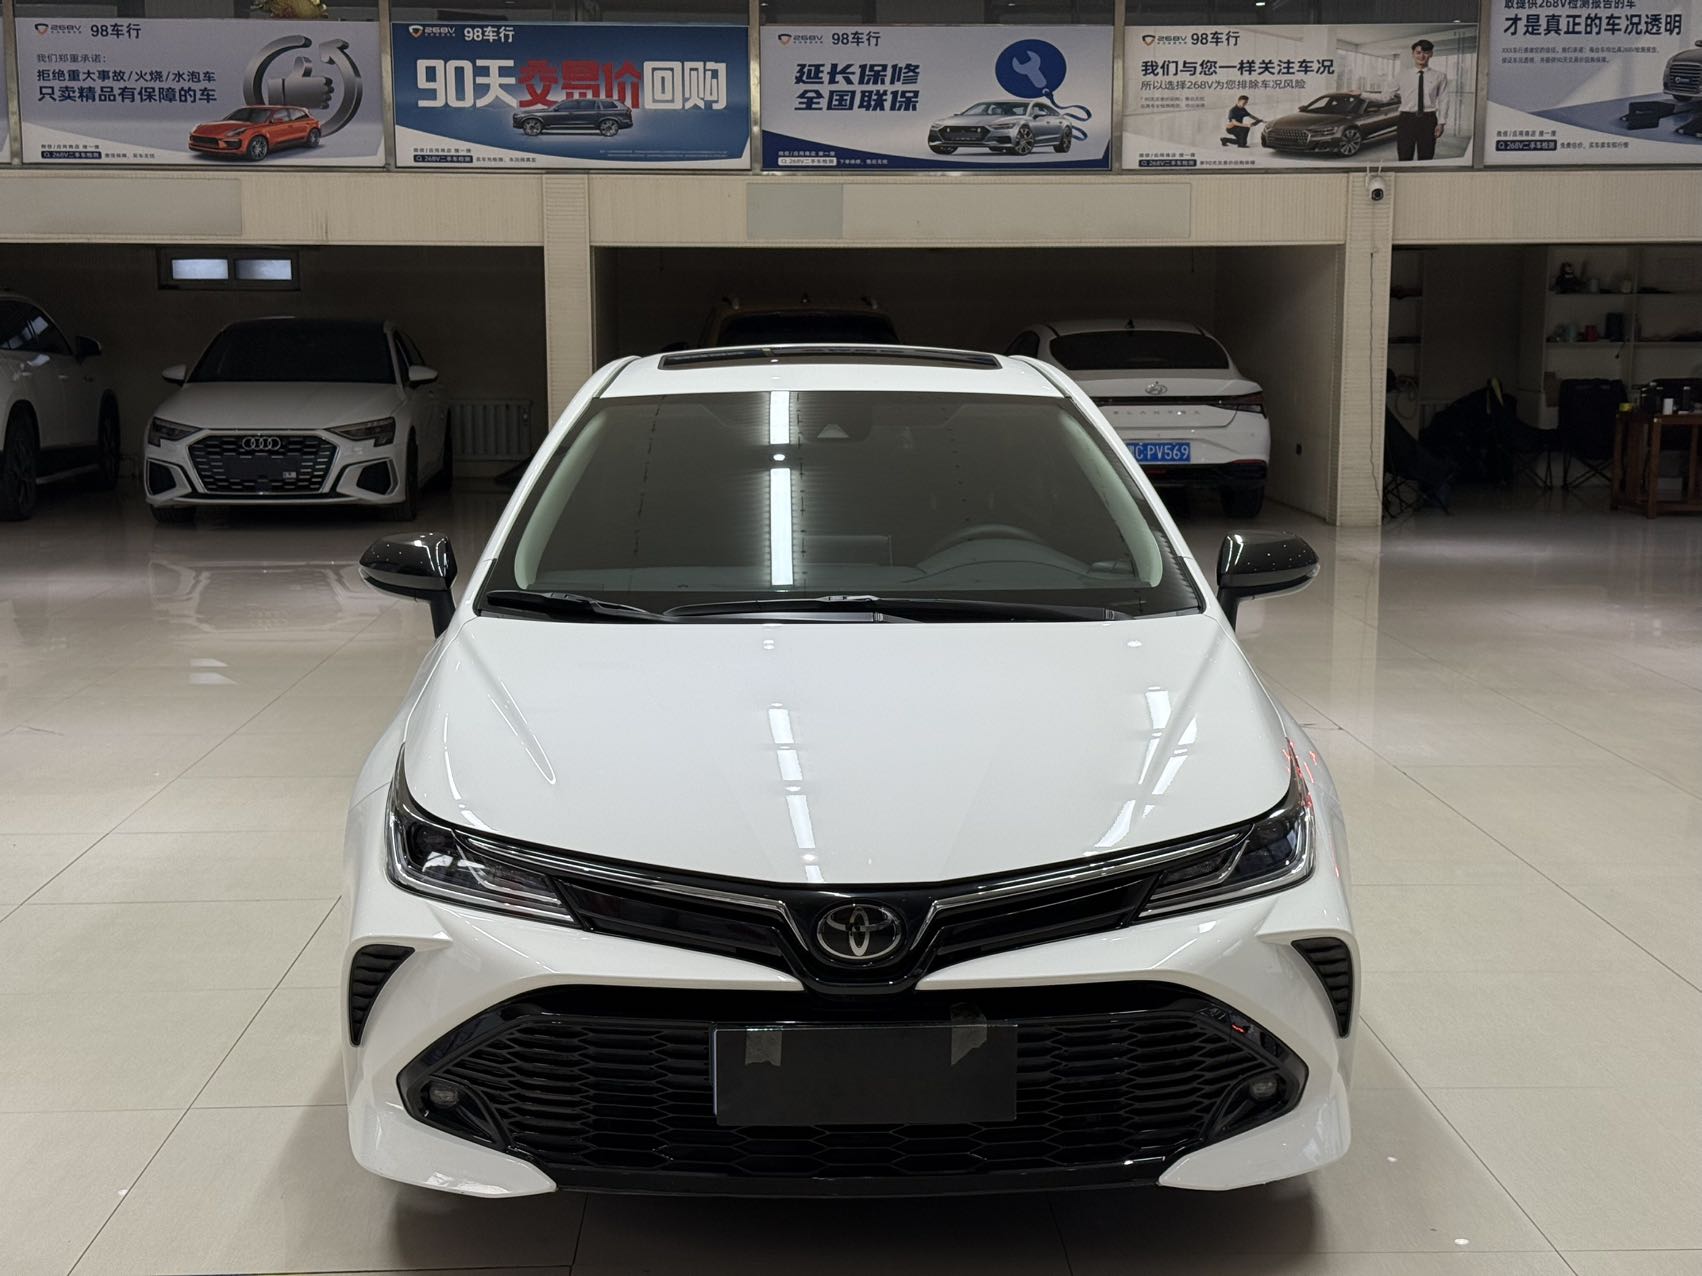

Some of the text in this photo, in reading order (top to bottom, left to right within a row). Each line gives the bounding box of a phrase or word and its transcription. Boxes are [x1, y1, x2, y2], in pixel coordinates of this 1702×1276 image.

[90, 23, 142, 39] 98车行
[1503, 13, 1682, 36] 才是真正的车况透明
[464, 26, 515, 43] 98车行
[831, 30, 881, 47] 98车行
[1190, 30, 1240, 47] 98车行
[37, 69, 217, 84] 拒绝重大事故/火烧/水泡车
[794, 63, 921, 86] 延长保修
[1141, 59, 1335, 77] 我们与您一样关注车况
[416, 58, 728, 111] 90天交易价回购
[1140, 79, 1306, 91] 所以选择268V为您排除车况风险
[38, 85, 218, 104] 只卖精品有保障的车
[794, 89, 920, 112] 全国联保
